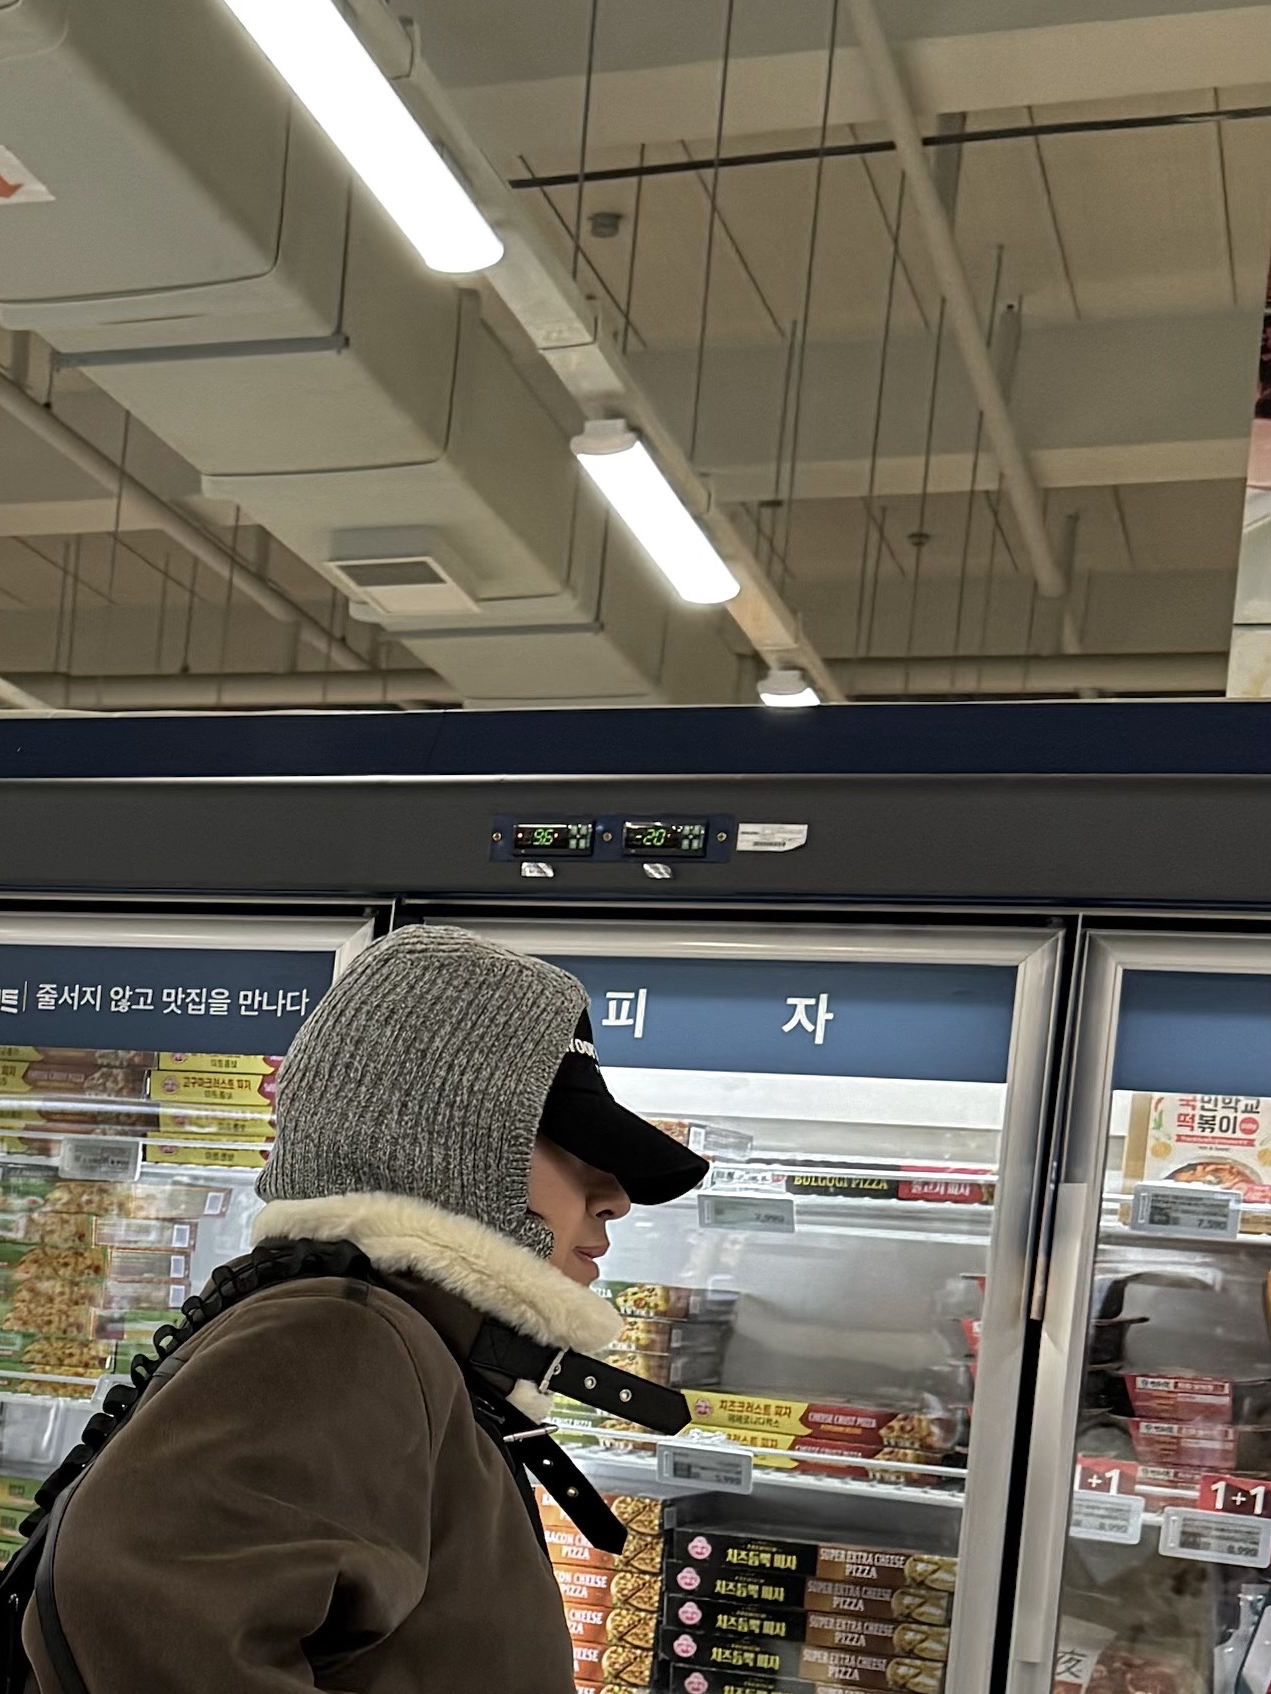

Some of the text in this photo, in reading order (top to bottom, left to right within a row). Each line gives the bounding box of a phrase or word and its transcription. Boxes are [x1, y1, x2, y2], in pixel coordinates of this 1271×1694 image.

[35, 983, 102, 1012] 줄서지
[109, 986, 154, 1013] 않고
[161, 987, 231, 1017] 맛집을
[238, 988, 310, 1018] 만나다
[1176, 1112, 1238, 1135] 떡볶이
[718, 1399, 792, 1419] 치즈크러스트 피자
[1210, 1480, 1266, 1515] 1+1
[561, 1545, 591, 1560] PIZZA
[820, 1549, 906, 1569] SUPER EXTRA CHEESE
[844, 1563, 878, 1579] PIZZA
[832, 1596, 865, 1612] PIZZA
[834, 1632, 866, 1647] PIZZA
[827, 1665, 860, 1681] PIZZA
